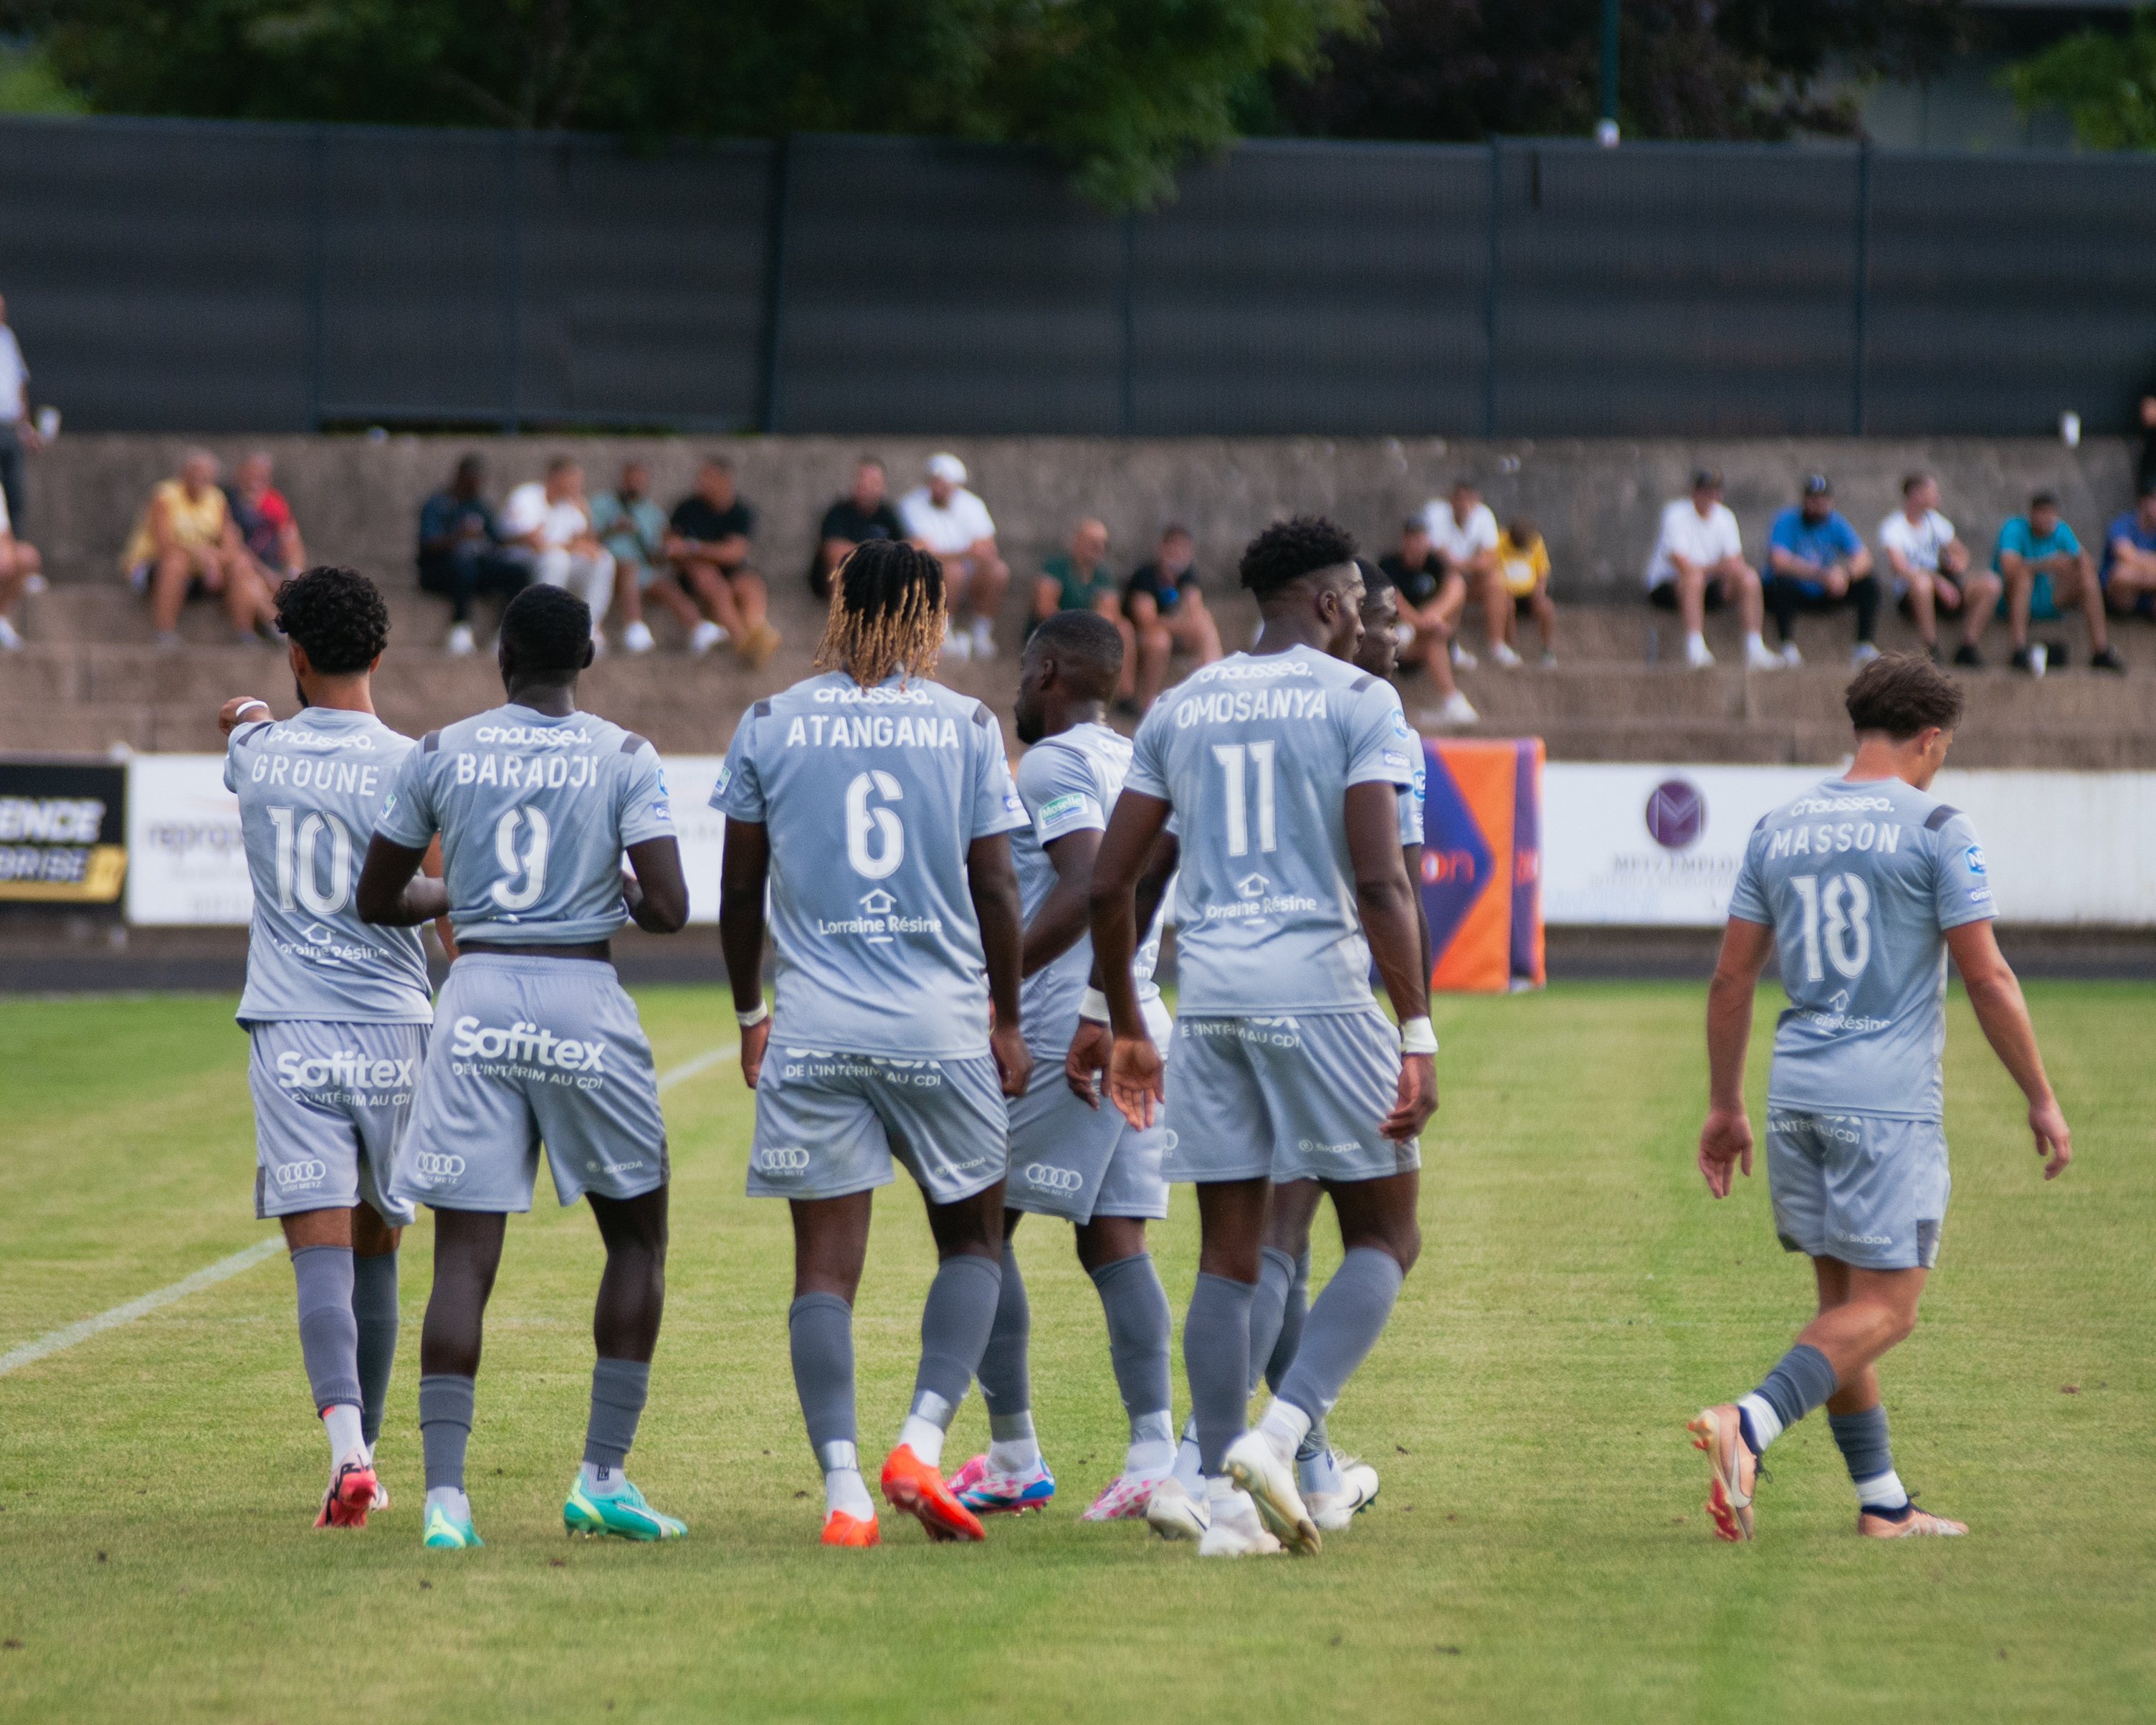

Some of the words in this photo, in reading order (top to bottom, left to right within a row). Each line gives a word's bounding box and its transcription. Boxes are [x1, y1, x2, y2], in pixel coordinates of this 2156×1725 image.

[1178, 688, 1327, 729] OMOSANYA
[787, 716, 959, 749] ATANGANA
[252, 754, 378, 797] GROUNE
[457, 753, 598, 788] BARADJI
[1041, 796, 1083, 819] Moselle
[1212, 740, 1277, 857] 11
[846, 770, 904, 880] 6
[1770, 822, 1902, 860] MASSON
[266, 805, 353, 916] 10
[491, 804, 551, 911] 9
[1262, 895, 1317, 914] Résine
[819, 916, 885, 935] Lorraine
[887, 915, 943, 933] Résine
[1790, 873, 1871, 982] 18
[451, 1016, 606, 1073] Sofitex
[1248, 1031, 1268, 1043] AU
[1272, 1033, 1300, 1047] CDI
[277, 1050, 414, 1088] Sofitex
[452, 1063, 472, 1075] DE
[549, 1073, 573, 1086] AU
[576, 1077, 604, 1090] CDI
[786, 1064, 805, 1077] DE
[808, 1060, 882, 1077] L'INTÉRIM
[887, 1072, 909, 1084] AU
[914, 1074, 941, 1087] CDI
[369, 1094, 388, 1107] AU
[1835, 1128, 1861, 1144] CDI
